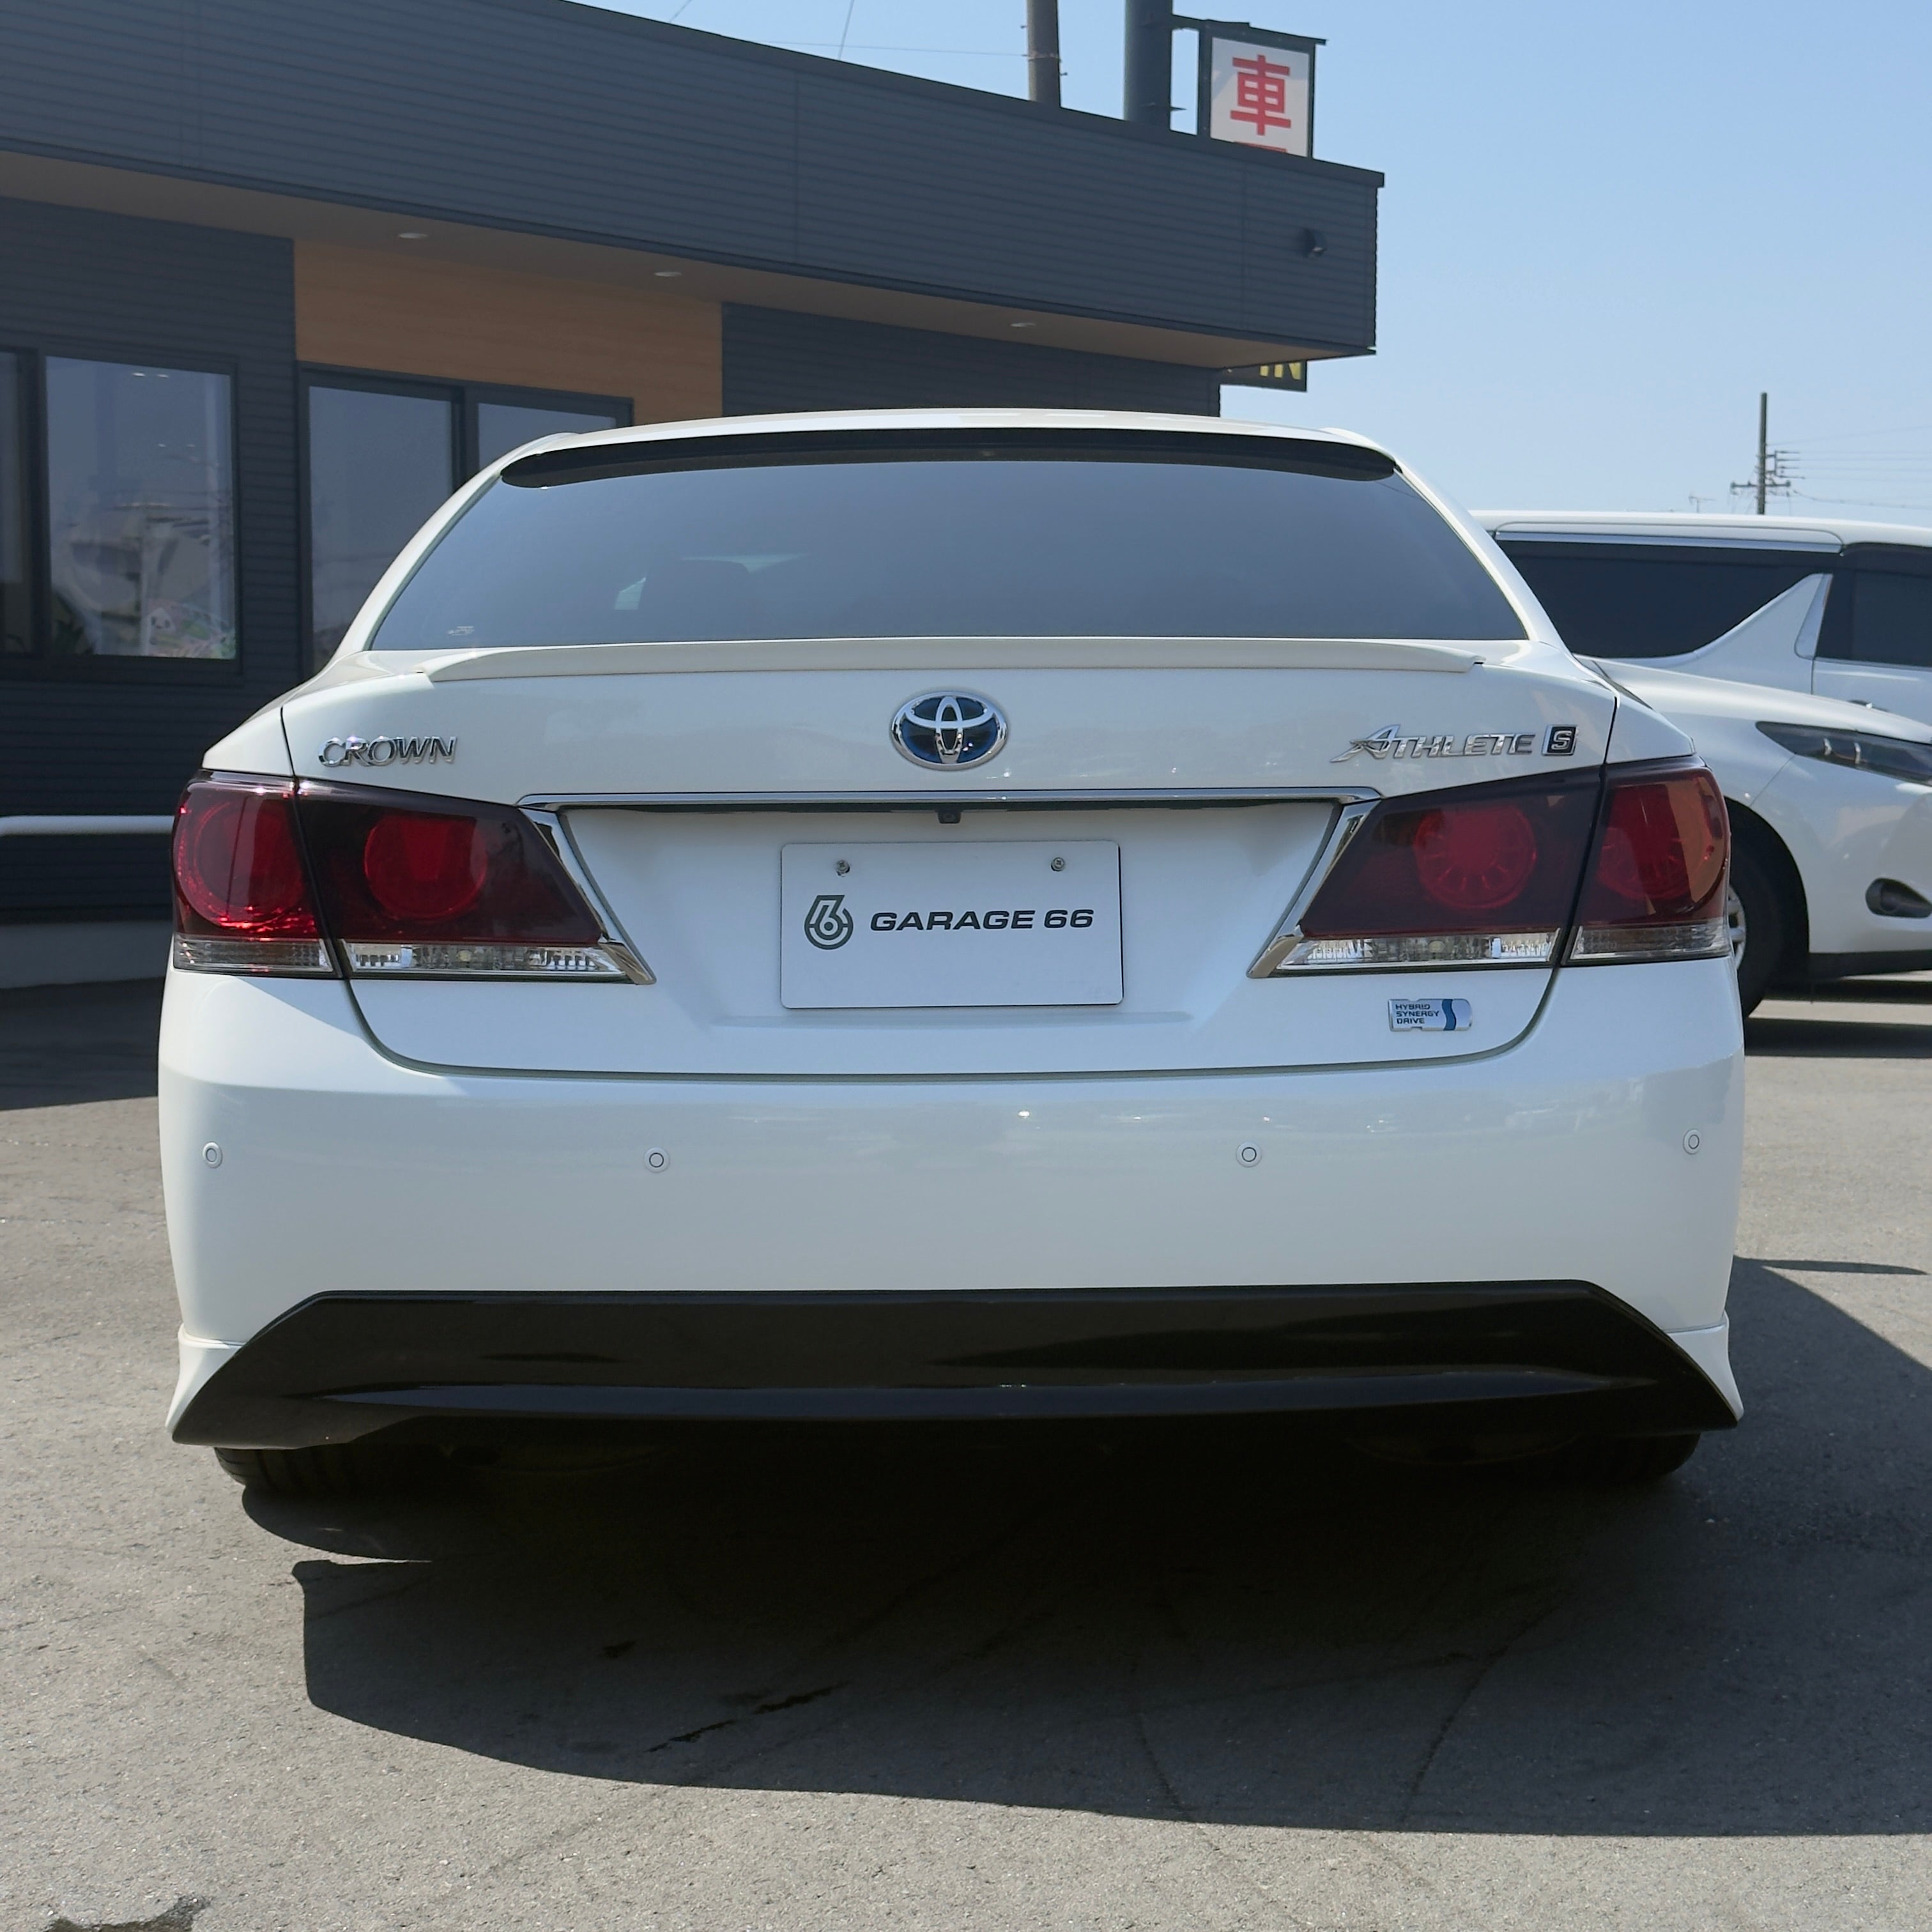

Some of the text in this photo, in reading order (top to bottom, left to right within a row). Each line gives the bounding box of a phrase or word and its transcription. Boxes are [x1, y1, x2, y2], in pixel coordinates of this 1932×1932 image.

[1230, 54, 1291, 153] 車
[318, 735, 458, 767] CROWN
[1330, 724, 1536, 763] ATHLETE
[870, 909, 1094, 931] GARAGE 66
